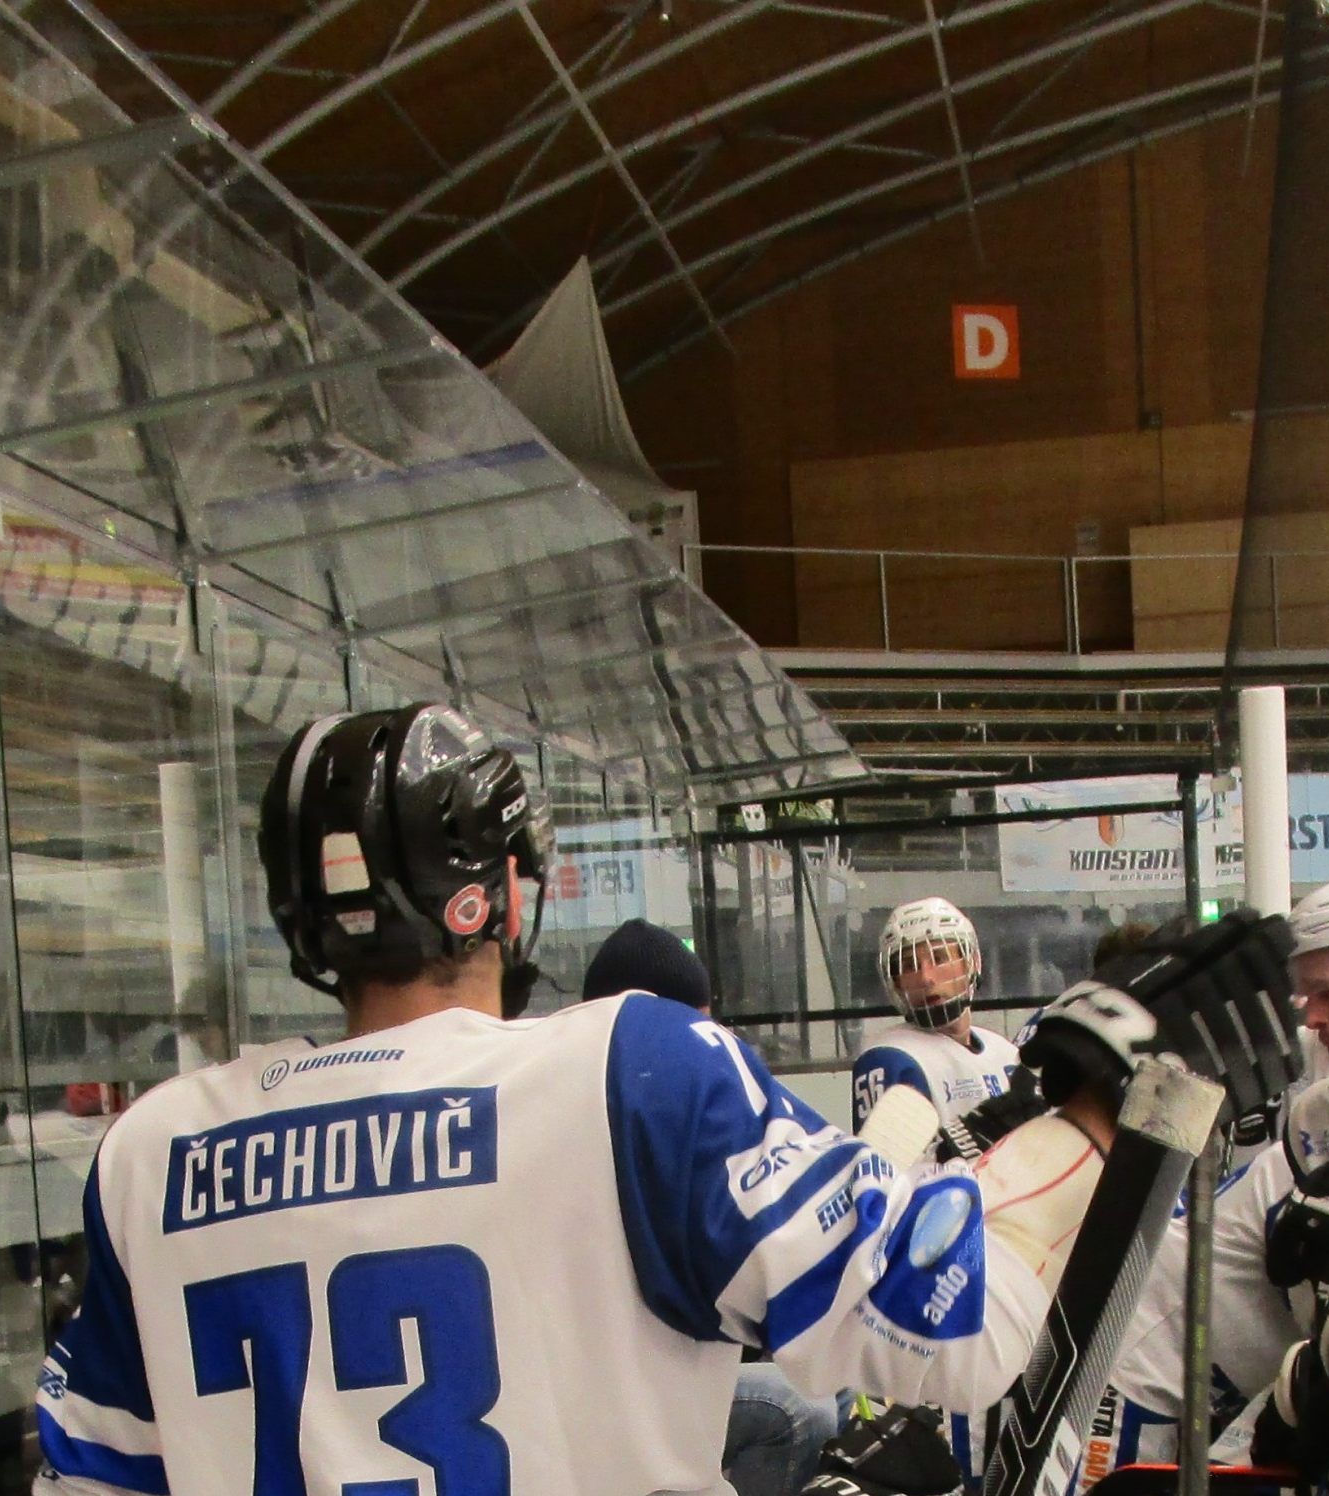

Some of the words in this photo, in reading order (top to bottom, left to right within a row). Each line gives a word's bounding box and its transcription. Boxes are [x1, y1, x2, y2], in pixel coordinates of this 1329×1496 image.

[964, 313, 1009, 371] D
[293, 1048, 406, 1074] WARRIOR
[181, 1096, 472, 1222] ČECHOVIČ
[923, 1264, 970, 1326] auto
